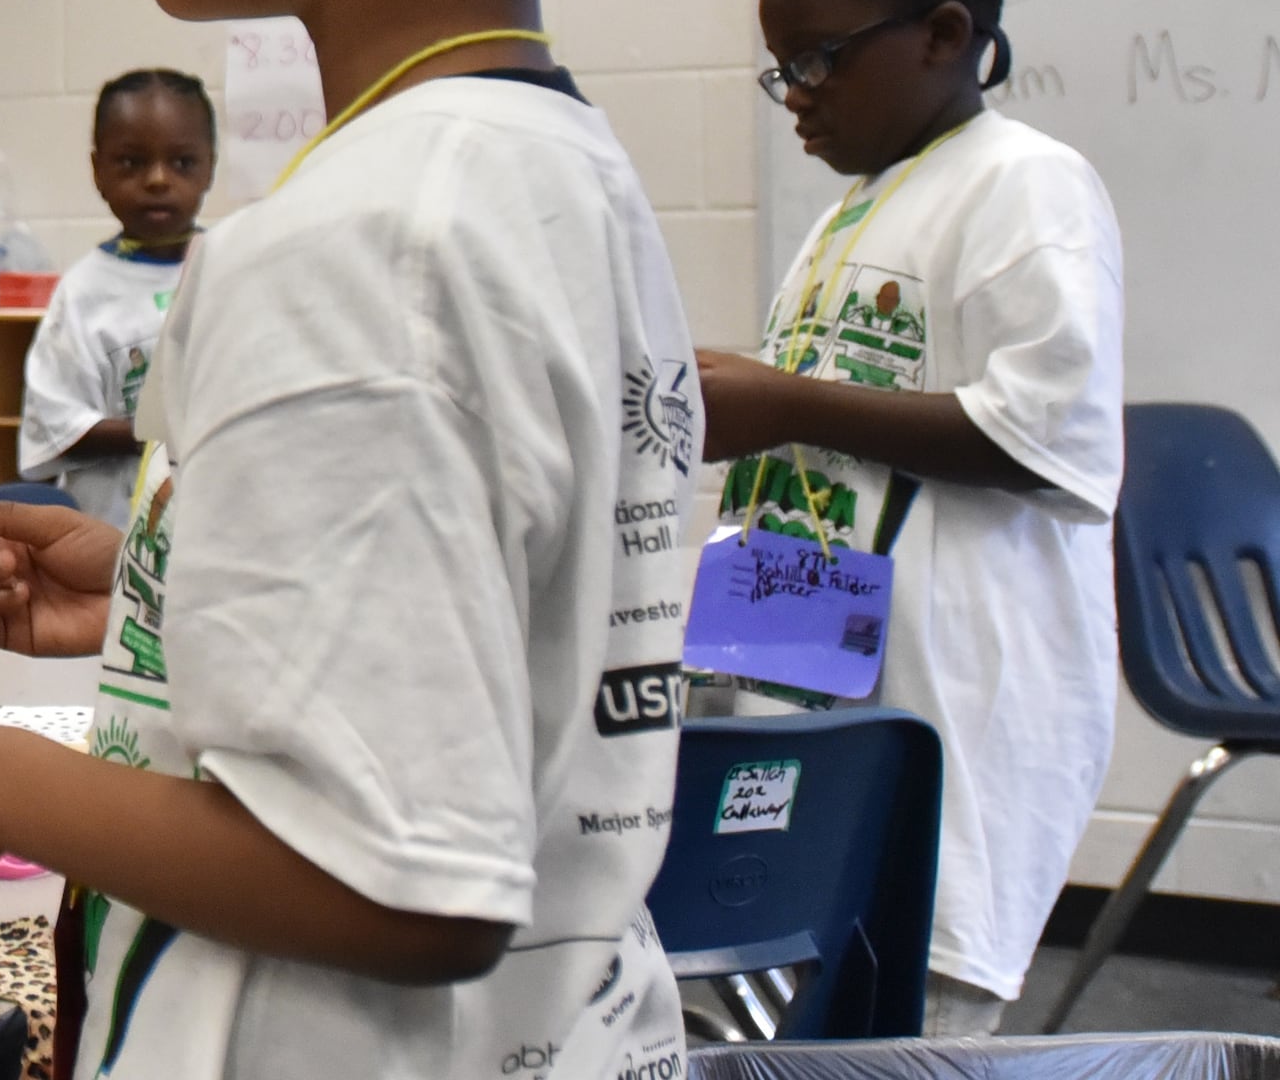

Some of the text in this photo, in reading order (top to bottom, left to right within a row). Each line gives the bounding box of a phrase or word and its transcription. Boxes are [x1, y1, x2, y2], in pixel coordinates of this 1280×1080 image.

[1127, 27, 1230, 107] Ms.
[621, 524, 673, 557] Hall
[578, 813, 641, 836] Major
